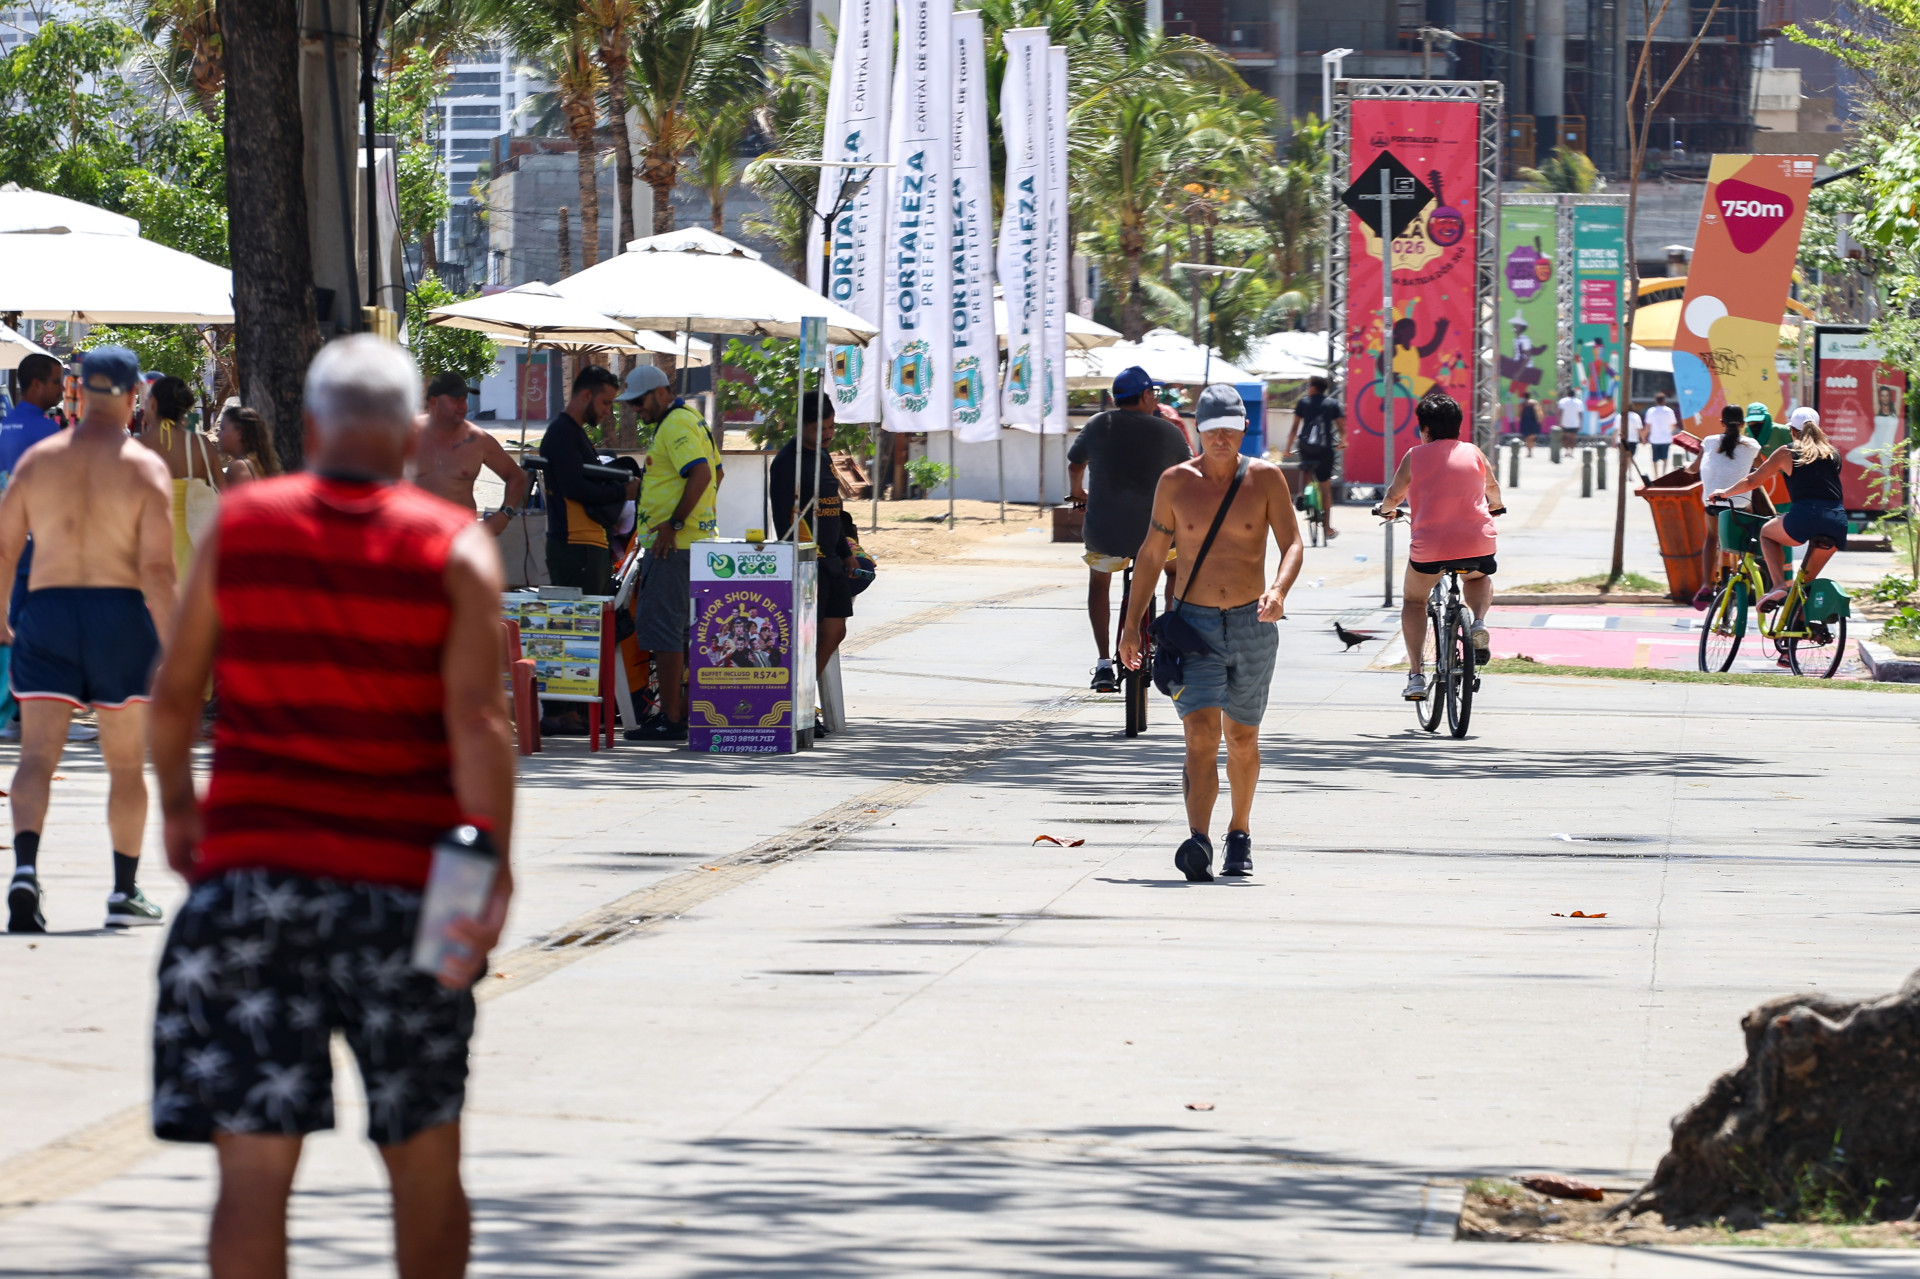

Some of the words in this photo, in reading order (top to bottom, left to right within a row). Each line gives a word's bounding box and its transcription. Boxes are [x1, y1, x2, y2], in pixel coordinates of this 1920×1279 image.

[918, 1, 928, 50] TODOS
[918, 53, 928, 70] DE
[958, 38, 968, 82] TODOS
[855, 52, 870, 112] CAPITAL
[957, 90, 966, 104] DE
[917, 75, 928, 132] CAPITAL
[953, 108, 964, 161] CAPITAL
[831, 130, 861, 305] ORTALZA
[1721, 200, 1784, 217] 750m
[898, 150, 924, 330] FORTALEZA
[921, 173, 938, 306] PREFEITURA
[1392, 241, 1425, 254] 026
[967, 199, 981, 323] PREFEITURA
[737, 553, 777, 562] ANTÔNIO
[738, 562, 777, 575] COCO
[724, 590, 762, 604] SHOW
[761, 598, 777, 612] DE
[697, 599, 724, 643] MELHOR
[699, 645, 708, 655] O
[722, 735, 737, 743] (85)
